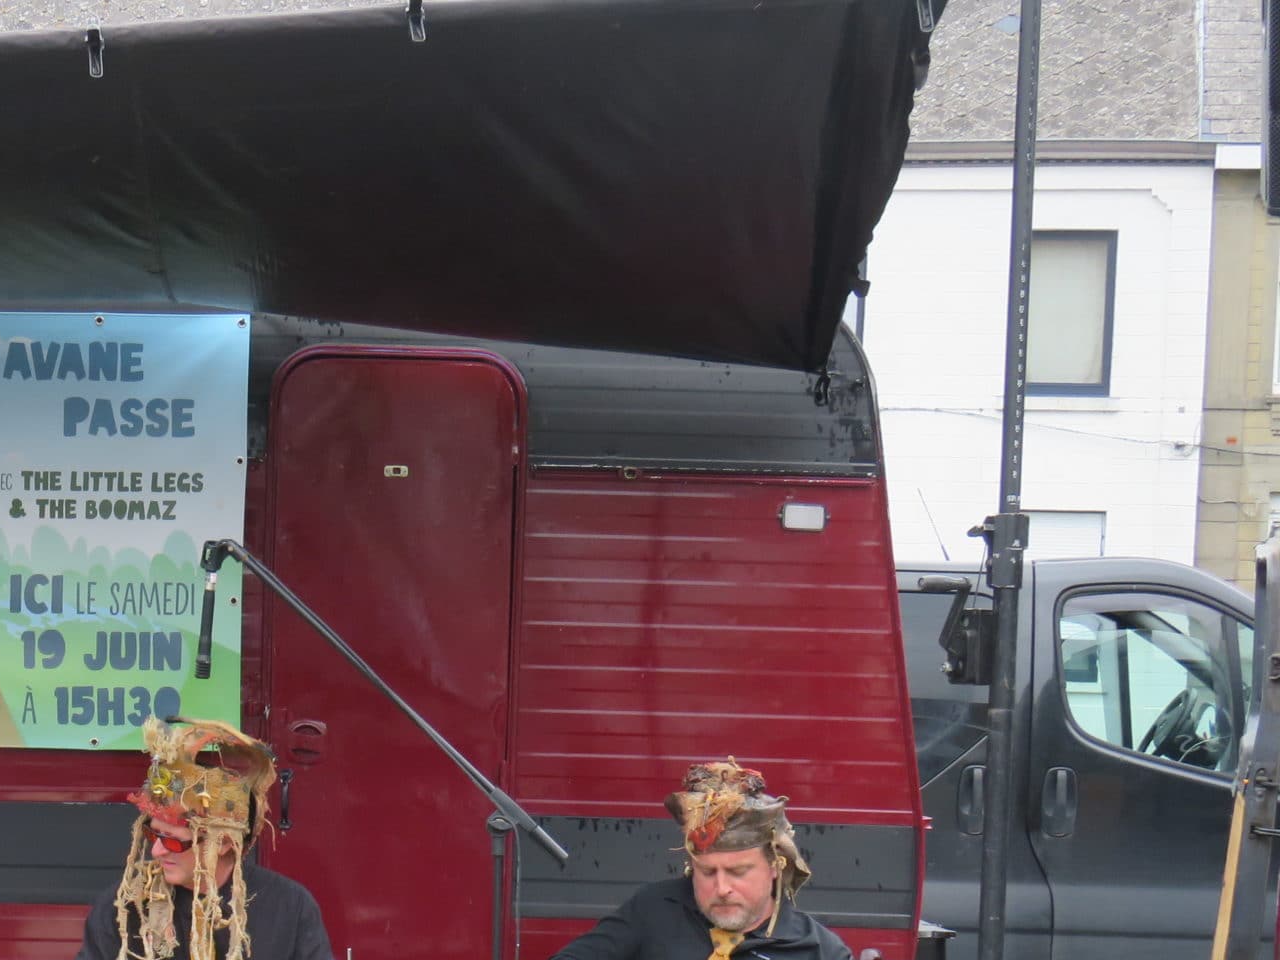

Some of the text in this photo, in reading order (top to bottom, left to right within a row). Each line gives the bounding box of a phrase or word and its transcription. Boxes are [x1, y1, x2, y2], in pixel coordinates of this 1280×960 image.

[63, 396, 195, 438] PASSE
[21, 470, 62, 491] THE
[70, 471, 143, 492] LITTLE
[150, 471, 204, 493] LEGS
[9, 498, 177, 521] & THE BOOMAZ
[9, 573, 195, 616] ICI LE SAMEDI
[21, 629, 182, 671] 19 JUIN
[22, 685, 181, 727] À 15H30
